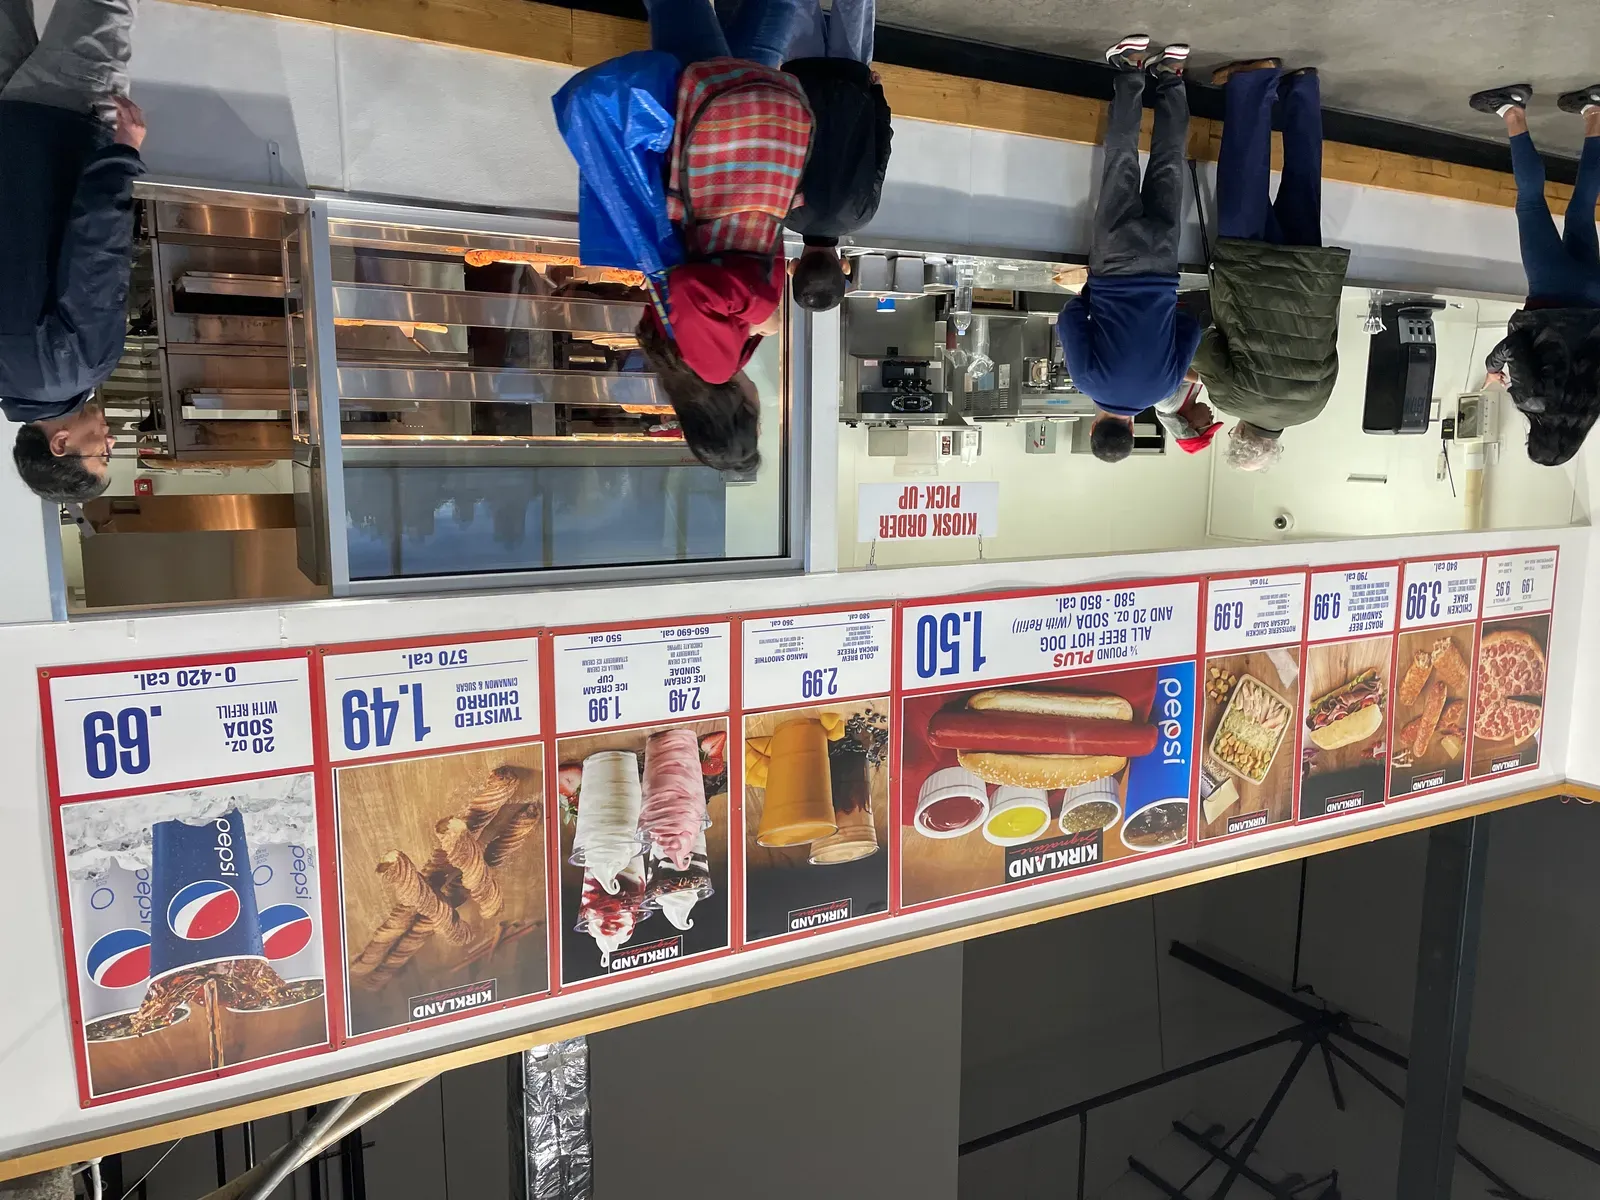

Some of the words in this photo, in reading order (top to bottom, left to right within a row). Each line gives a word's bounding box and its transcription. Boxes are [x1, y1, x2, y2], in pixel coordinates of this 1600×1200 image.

[898, 486, 960, 509] PICK-UP
[879, 514, 927, 538] ORDER
[932, 513, 977, 536] KIOSK
[1434, 563, 1445, 572] cal.
[1447, 562, 1457, 571] 840
[1344, 573, 1355, 582] cal.
[1357, 572, 1367, 581] 790
[1496, 581, 1510, 596] 9.95
[1522, 578, 1534, 593] 1.99
[1056, 597, 1076, 613] cal.
[1081, 595, 1101, 611] 850
[1114, 592, 1135, 608] 580
[1406, 581, 1442, 620] 3.99
[1453, 594, 1468, 603] BAKE
[1150, 606, 1173, 622] AND
[1314, 593, 1340, 621] 9.99
[1447, 603, 1472, 615] CHICKEN
[1046, 613, 1071, 630] (With
[1076, 612, 1108, 629] SODA
[1114, 611, 1129, 622] oz.
[1134, 609, 1146, 624] 20
[1214, 601, 1243, 631] 6.99
[1271, 619, 1289, 627] CAESAR
[1352, 610, 1382, 622] SANDWICH
[677, 627, 709, 636] 650-690
[1012, 618, 1042, 634] Refill)
[1268, 625, 1296, 634] ROTISSERIE
[1349, 623, 1363, 632] BEEF
[1365, 620, 1383, 630] ROAST
[588, 636, 603, 644] cal.
[606, 634, 621, 642] 550
[660, 630, 674, 638] cal.
[1071, 632, 1094, 648] HOT
[1099, 628, 1126, 645] BEEF
[1131, 626, 1152, 641] ALL
[1246, 629, 1267, 637] CHICKEN
[916, 610, 986, 679] 1.50
[1040, 634, 1066, 652] DOG
[438, 650, 468, 666] 570
[754, 655, 784, 664] SMOOTHIE
[1053, 650, 1094, 667] PLUS
[1097, 646, 1127, 660] POUND
[402, 653, 433, 669] cal.
[670, 666, 700, 676] SUNDAE
[133, 672, 169, 690] cal.
[478, 681, 482, 690] &
[485, 677, 518, 689] CINNAMON
[597, 675, 613, 683] CUP
[664, 676, 691, 686] CREAM
[694, 675, 705, 683] ICE
[802, 668, 838, 698] 2.99
[456, 683, 476, 692] SUGAR
[583, 685, 612, 695] CREAM
[615, 683, 628, 691] ICE
[456, 690, 518, 711] CHURRO
[669, 687, 700, 712] 2.49
[216, 704, 249, 719] REFILL
[251, 701, 278, 716] WITH
[589, 696, 621, 722] 1.99
[342, 683, 431, 751] 1.49
[455, 707, 522, 728] TWISTED
[1158, 678, 1185, 764] pepsi
[223, 718, 273, 738] SODA
[83, 706, 162, 779] .69
[225, 739, 247, 752] oz.
[252, 737, 275, 753] 20
[1492, 759, 1519, 772] KIRKLAND
[1412, 776, 1443, 790] KIRKLAND
[1326, 797, 1362, 812] KIRKLAND
[1229, 817, 1266, 832] KIRKLAND
[214, 818, 239, 876] pepsi
[1009, 830, 1098, 854] Signature
[1009, 843, 1097, 877] KIRKLAND
[288, 846, 311, 899] pepsi
[791, 908, 847, 929] KIRKLAND
[612, 946, 678, 970] KIRKLAND
[413, 990, 492, 1017] KIRKLAND
